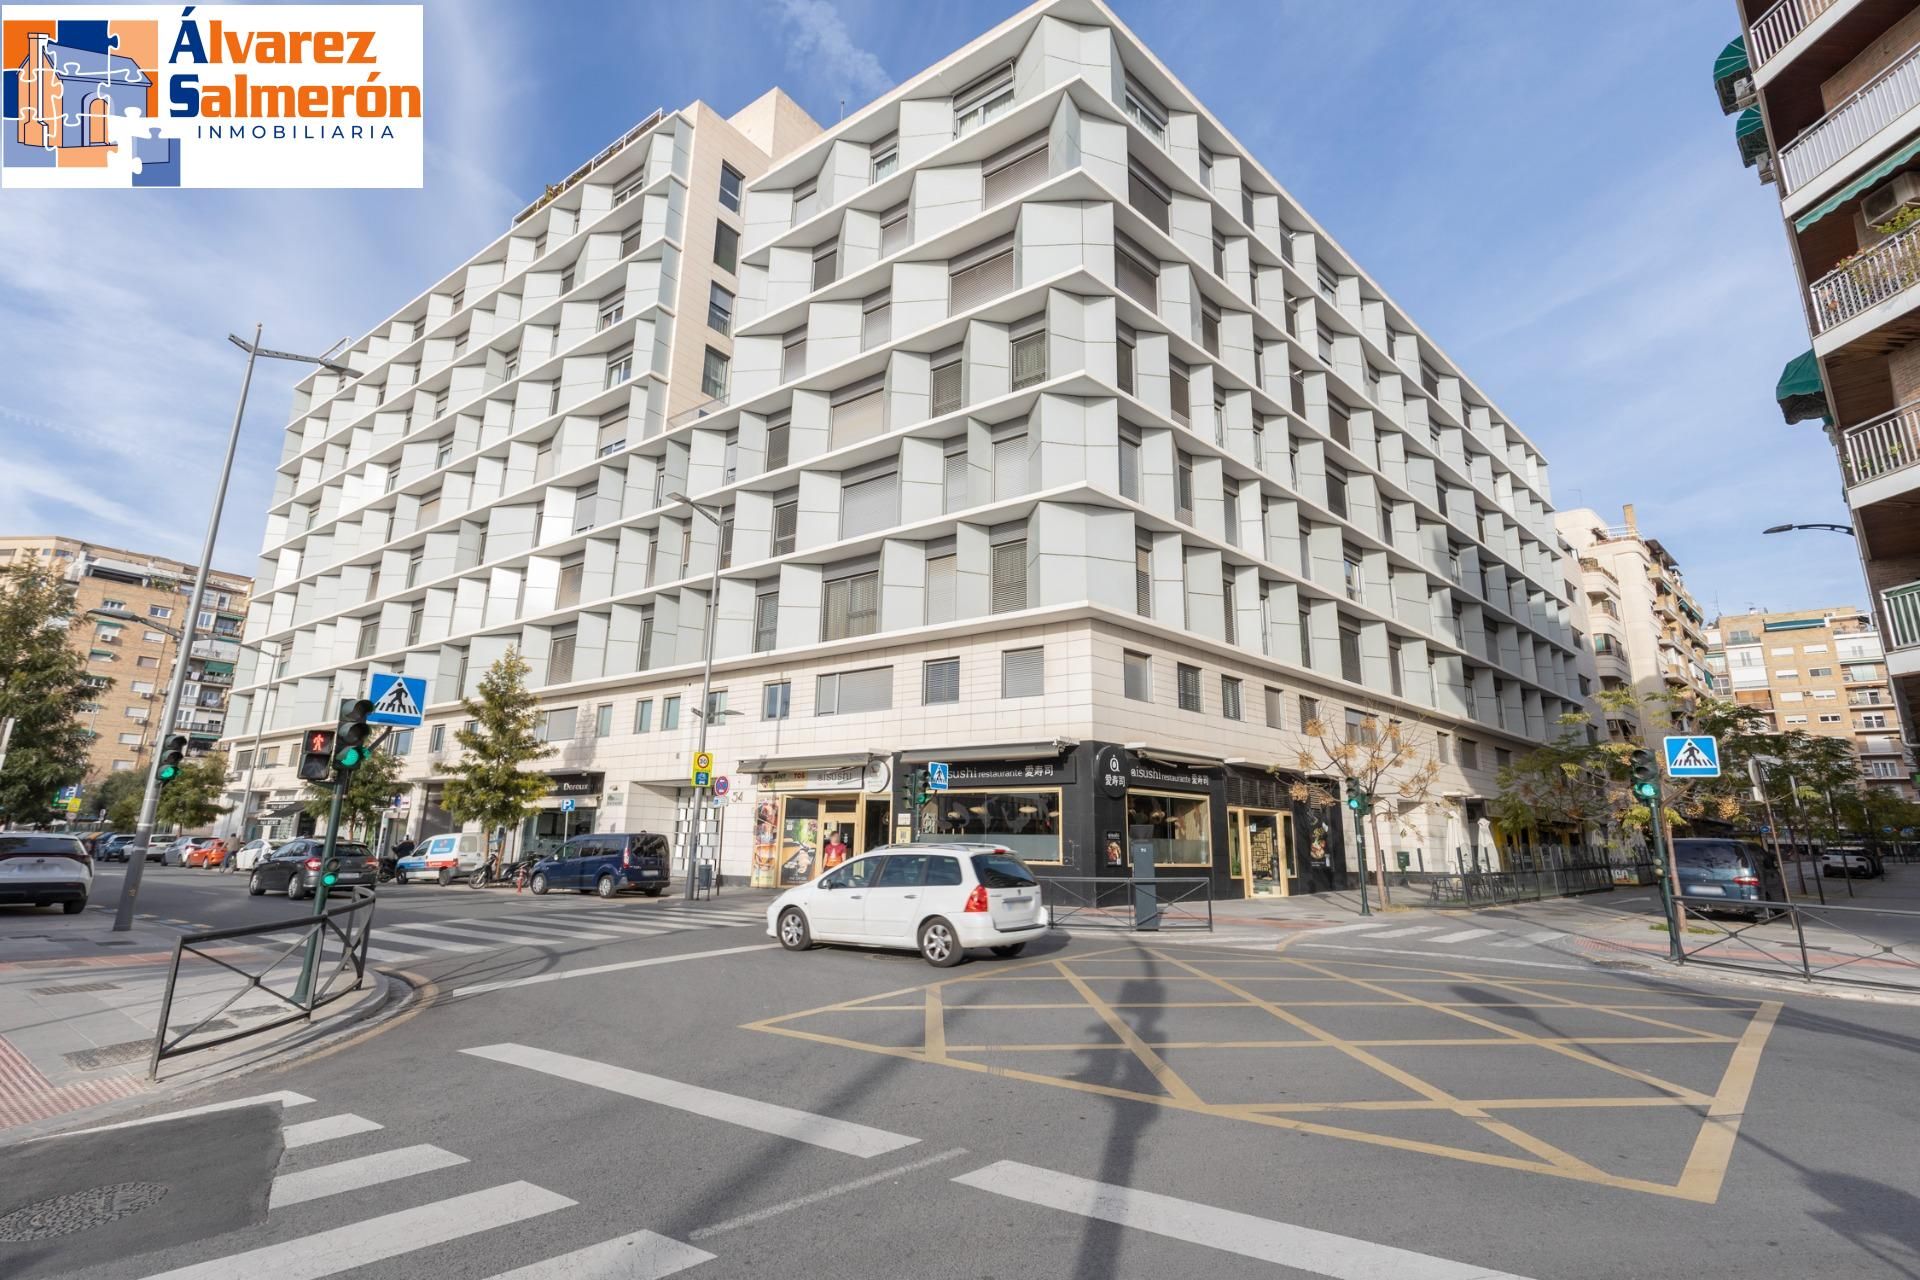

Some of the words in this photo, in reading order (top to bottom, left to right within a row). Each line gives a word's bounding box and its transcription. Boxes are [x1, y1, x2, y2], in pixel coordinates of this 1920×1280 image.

[978, 769, 1023, 778] restaurante
[1130, 766, 1161, 780] aisushi
[1161, 773, 1191, 783] restaurante
